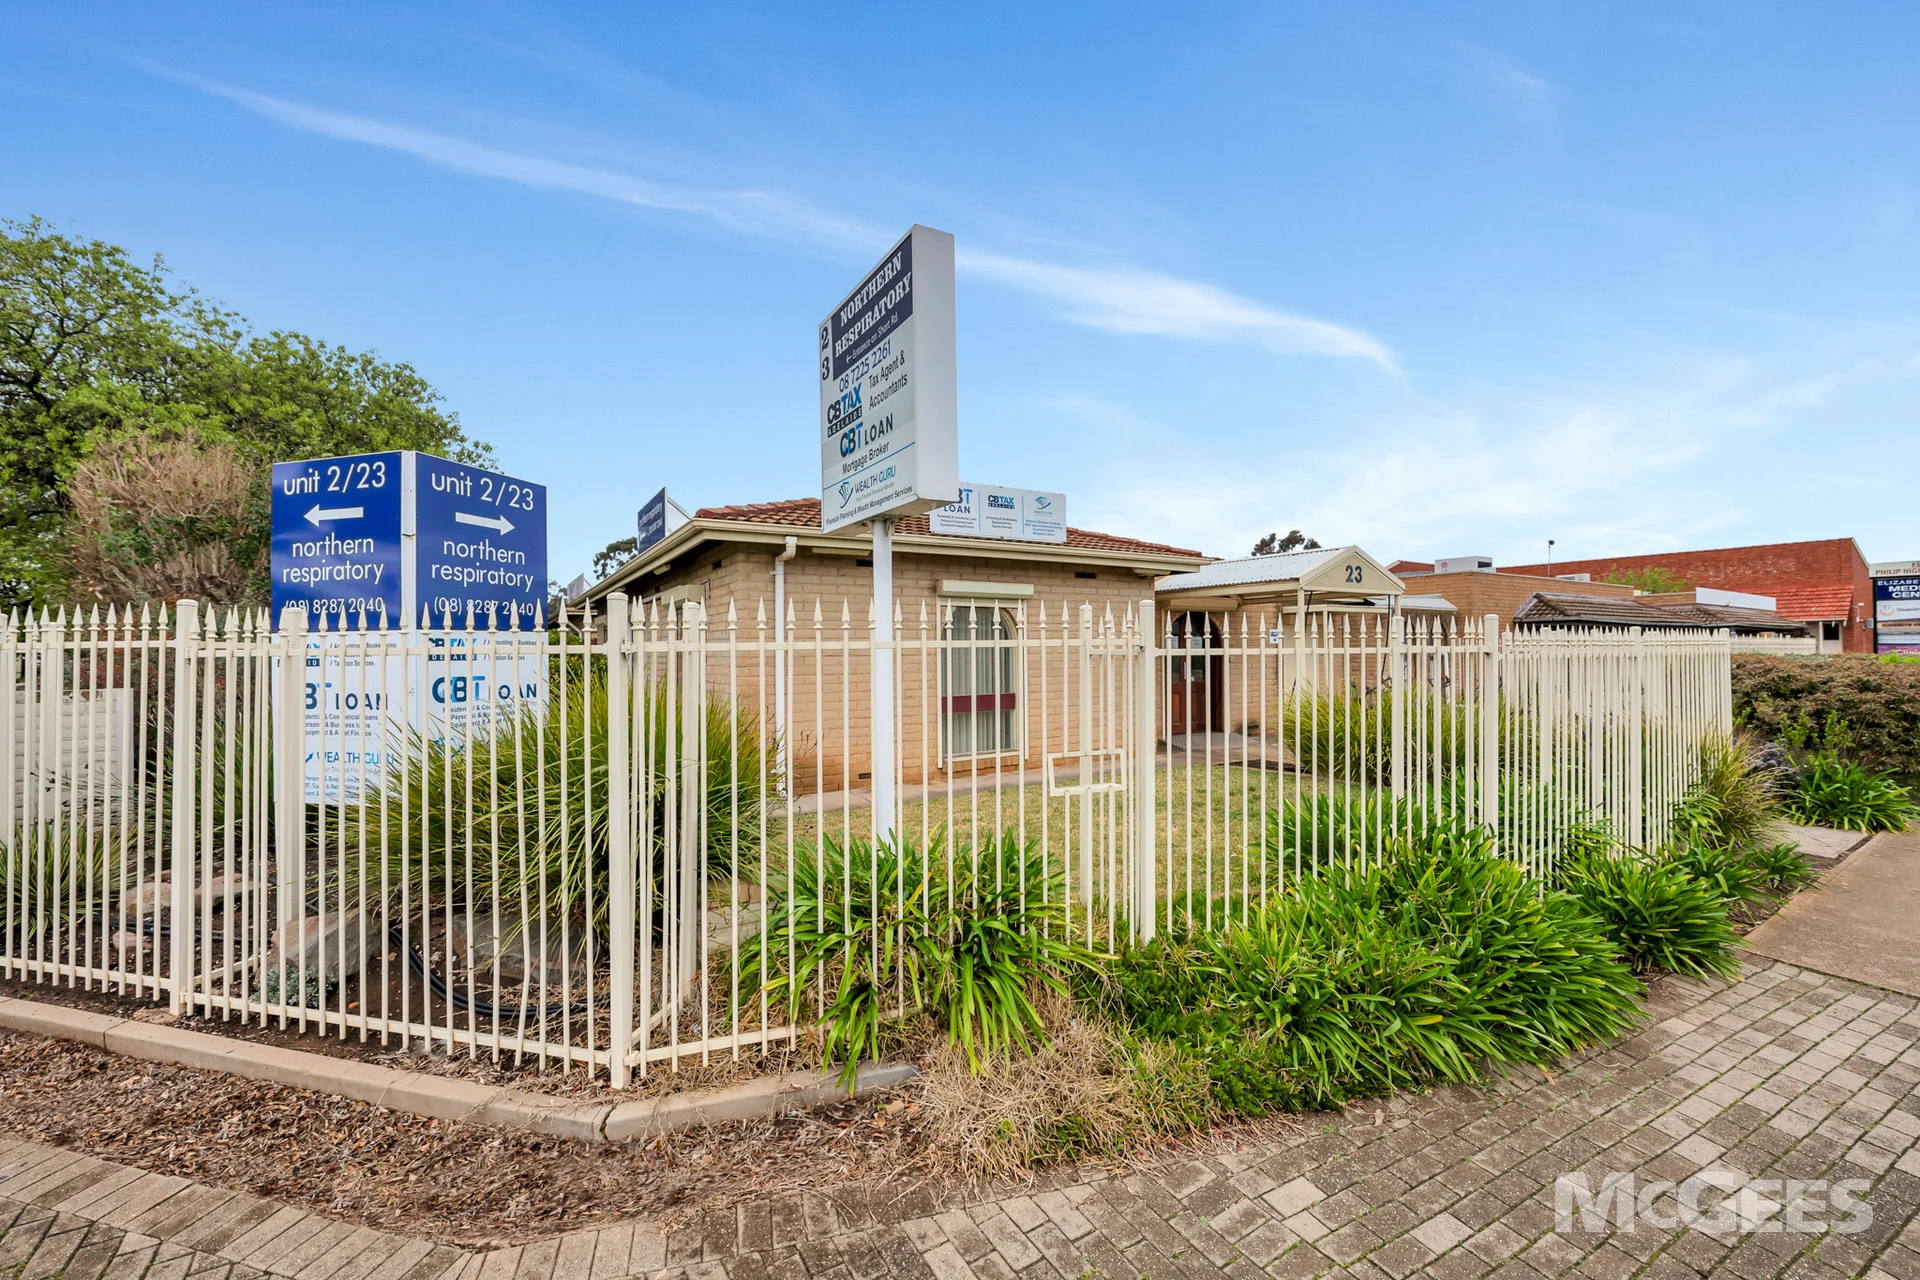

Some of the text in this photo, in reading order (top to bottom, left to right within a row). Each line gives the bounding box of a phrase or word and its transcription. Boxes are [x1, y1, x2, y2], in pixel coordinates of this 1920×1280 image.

[840, 252, 902, 327] NORTHERN
[835, 272, 912, 358] RESPIRATORY
[852, 340, 870, 360] Entrance
[878, 320, 890, 336] Short
[839, 339, 891, 393] 08 7225 2261
[869, 350, 905, 388] Tax Agent &
[869, 373, 908, 410] Accountants
[840, 413, 893, 457] CBT LOAN
[842, 442, 889, 475] Mortgage Broker
[284, 461, 386, 496] unit 2/23
[432, 472, 534, 511] unit 2/23
[854, 465, 896, 494] WEALTH GURU
[826, 515, 839, 526] Financial
[840, 508, 854, 522] Planning
[858, 502, 869, 512] Wealth
[870, 493, 894, 509] Management
[894, 485, 912, 500] Services
[944, 504, 970, 514] LOAN
[292, 532, 374, 557] northern
[444, 539, 525, 565] northern
[283, 560, 384, 587] respiratory
[432, 562, 534, 592] respiratory
[1345, 565, 1363, 584] 23
[313, 598, 345, 614] 8287
[348, 597, 384, 613] 2040
[434, 597, 462, 615] (08)
